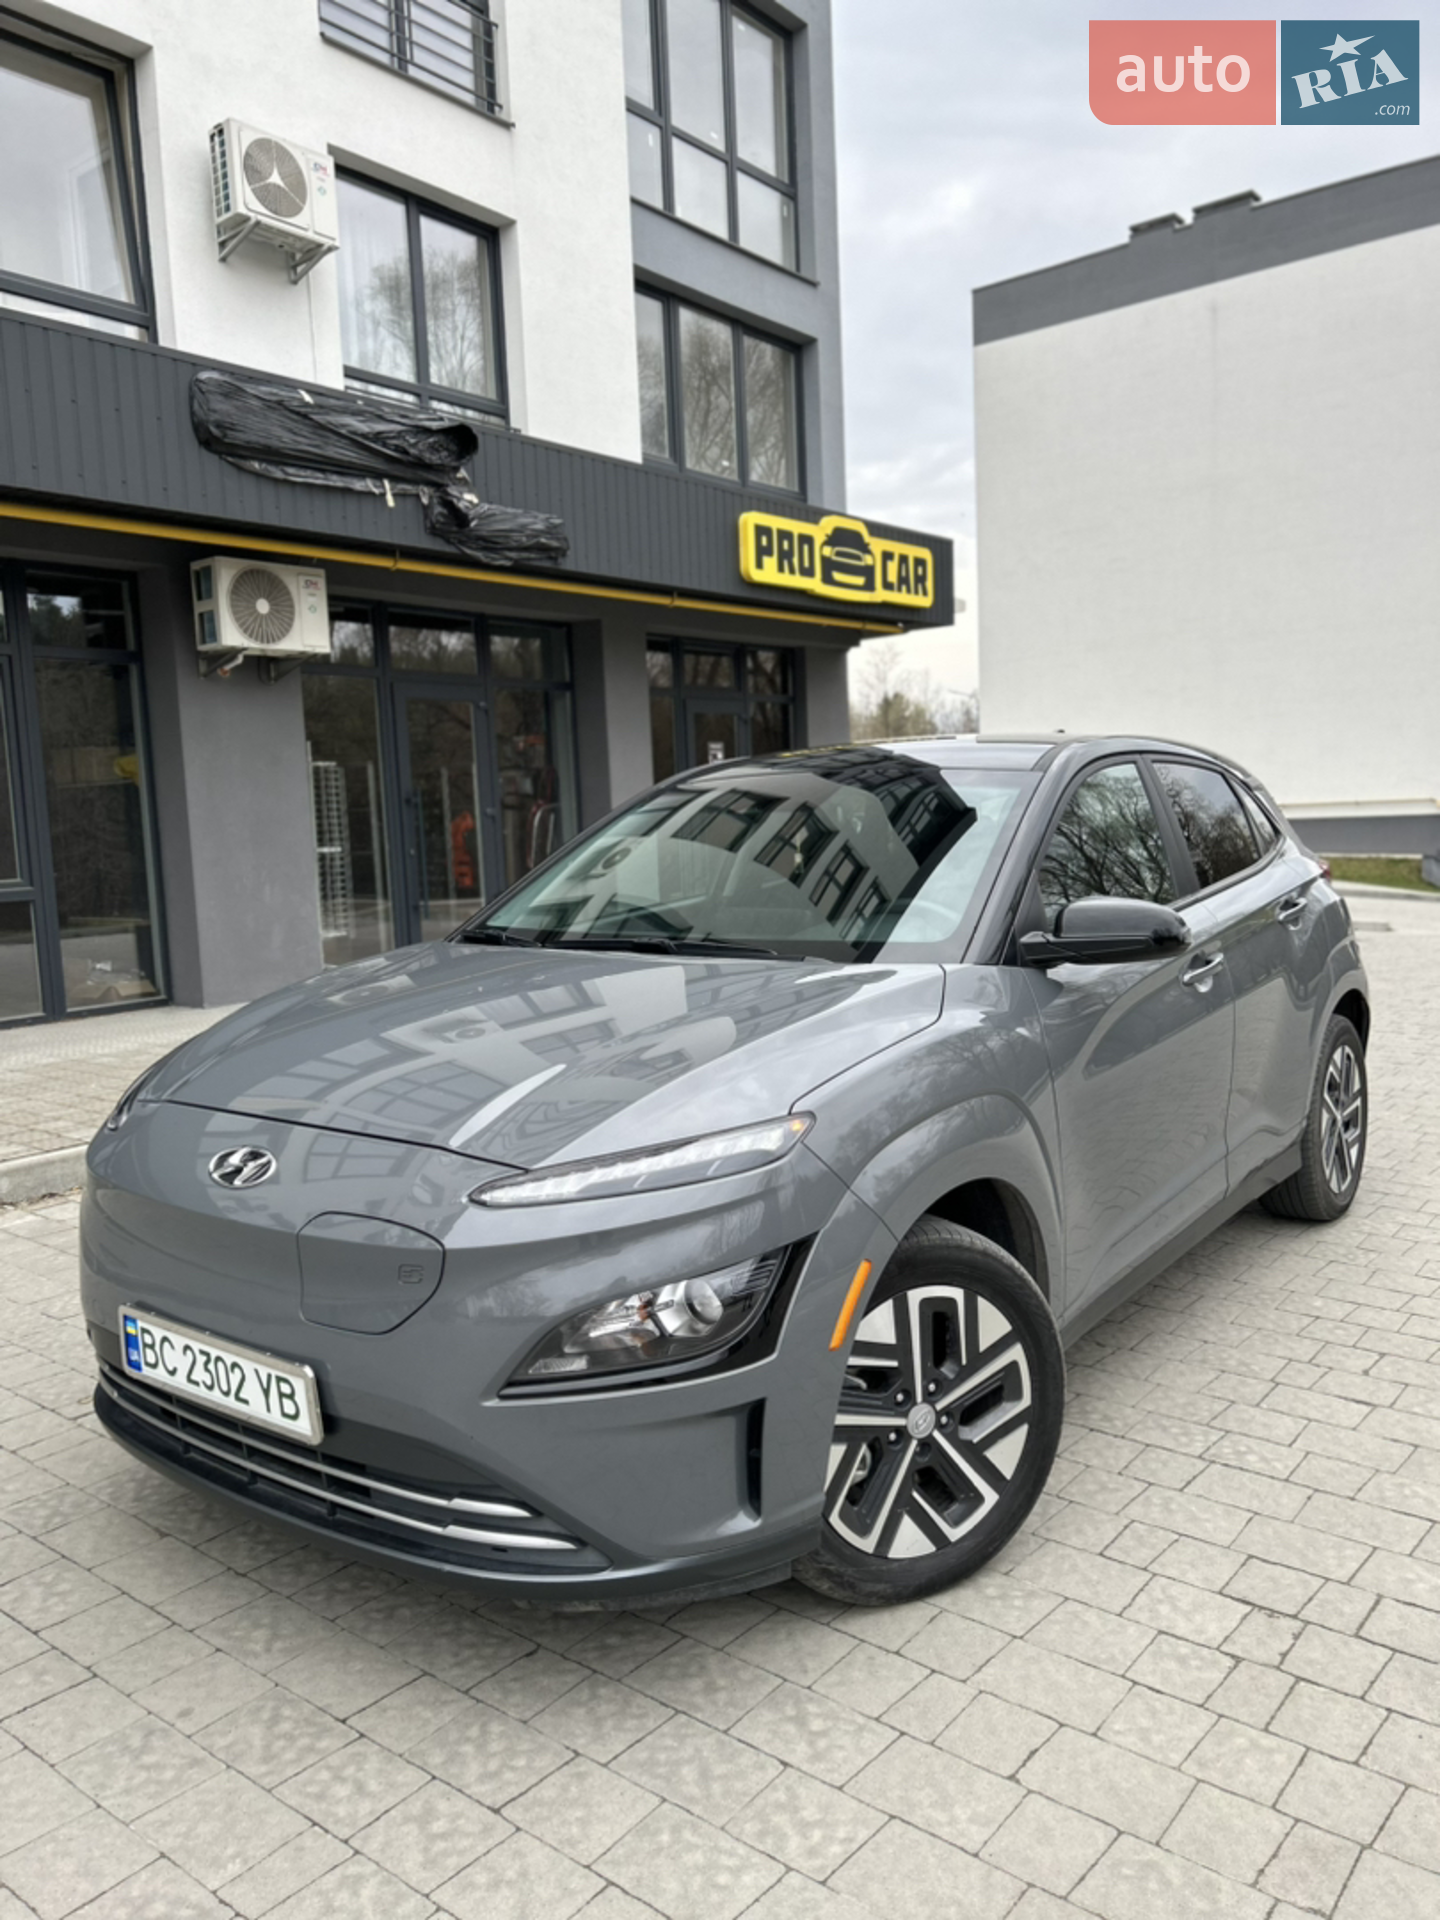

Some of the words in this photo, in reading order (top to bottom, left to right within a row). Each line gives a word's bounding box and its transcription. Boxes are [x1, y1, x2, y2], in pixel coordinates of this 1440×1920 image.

[754, 523, 816, 579] PRO
[881, 549, 929, 598] CAR
[140, 1326, 178, 1377] BC
[182, 1344, 250, 1406] 2302
[254, 1367, 301, 1421] YB
